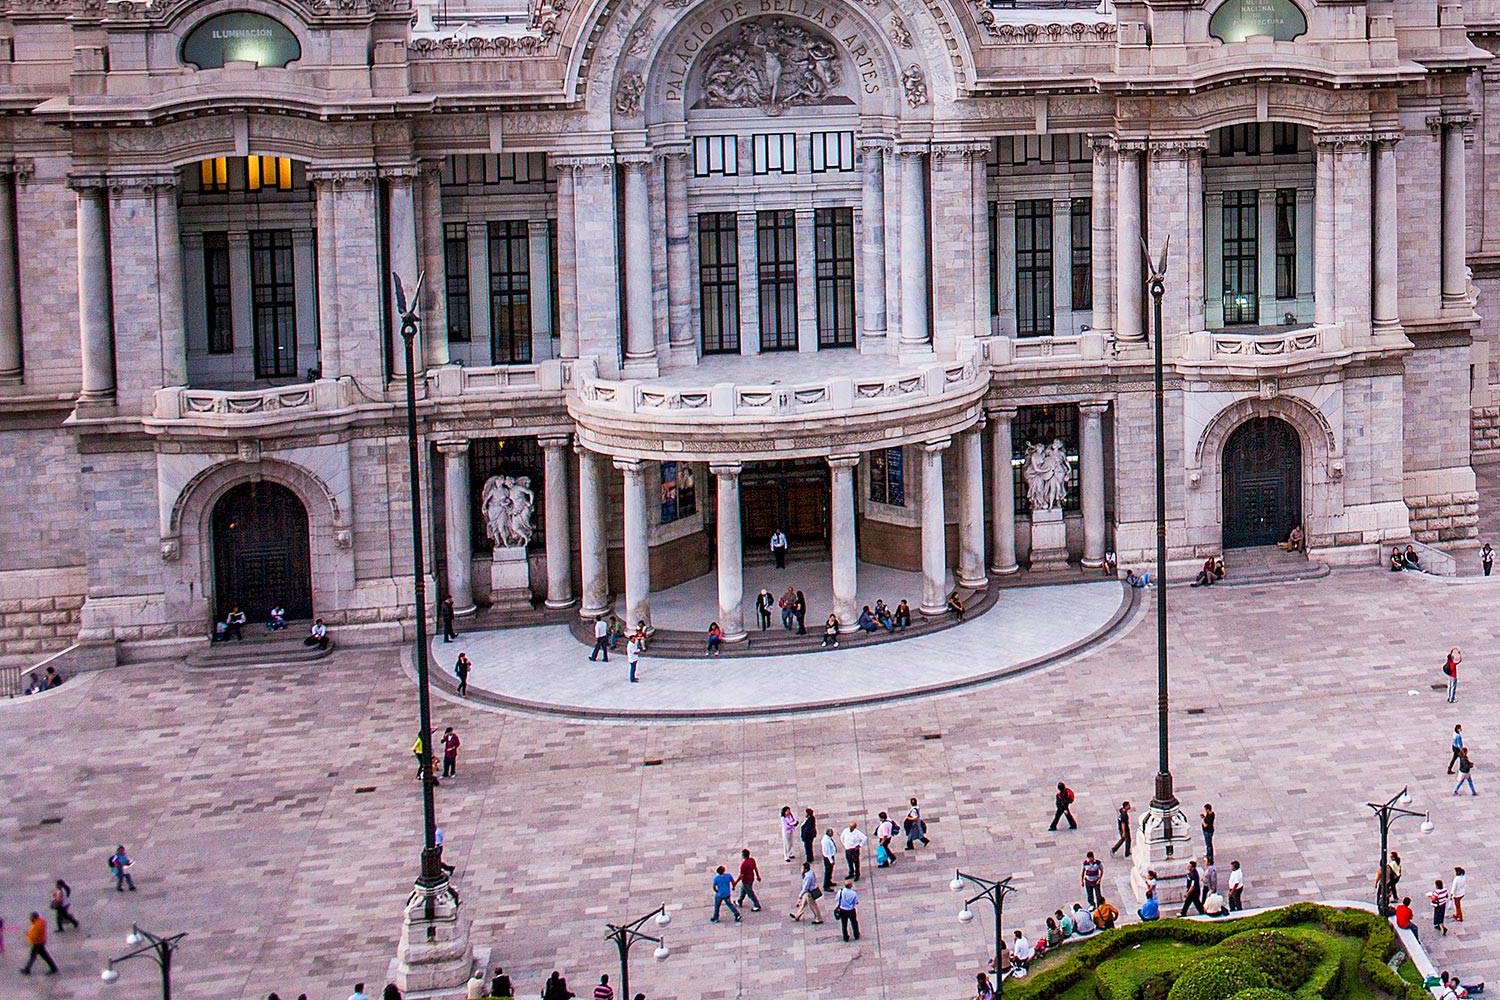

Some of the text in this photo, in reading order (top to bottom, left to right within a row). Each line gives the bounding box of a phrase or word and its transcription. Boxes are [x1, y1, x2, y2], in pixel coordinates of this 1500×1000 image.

[666, 21, 714, 101] PALACIO
[720, 1, 748, 22] DE
[842, 33, 880, 95] ARTES
